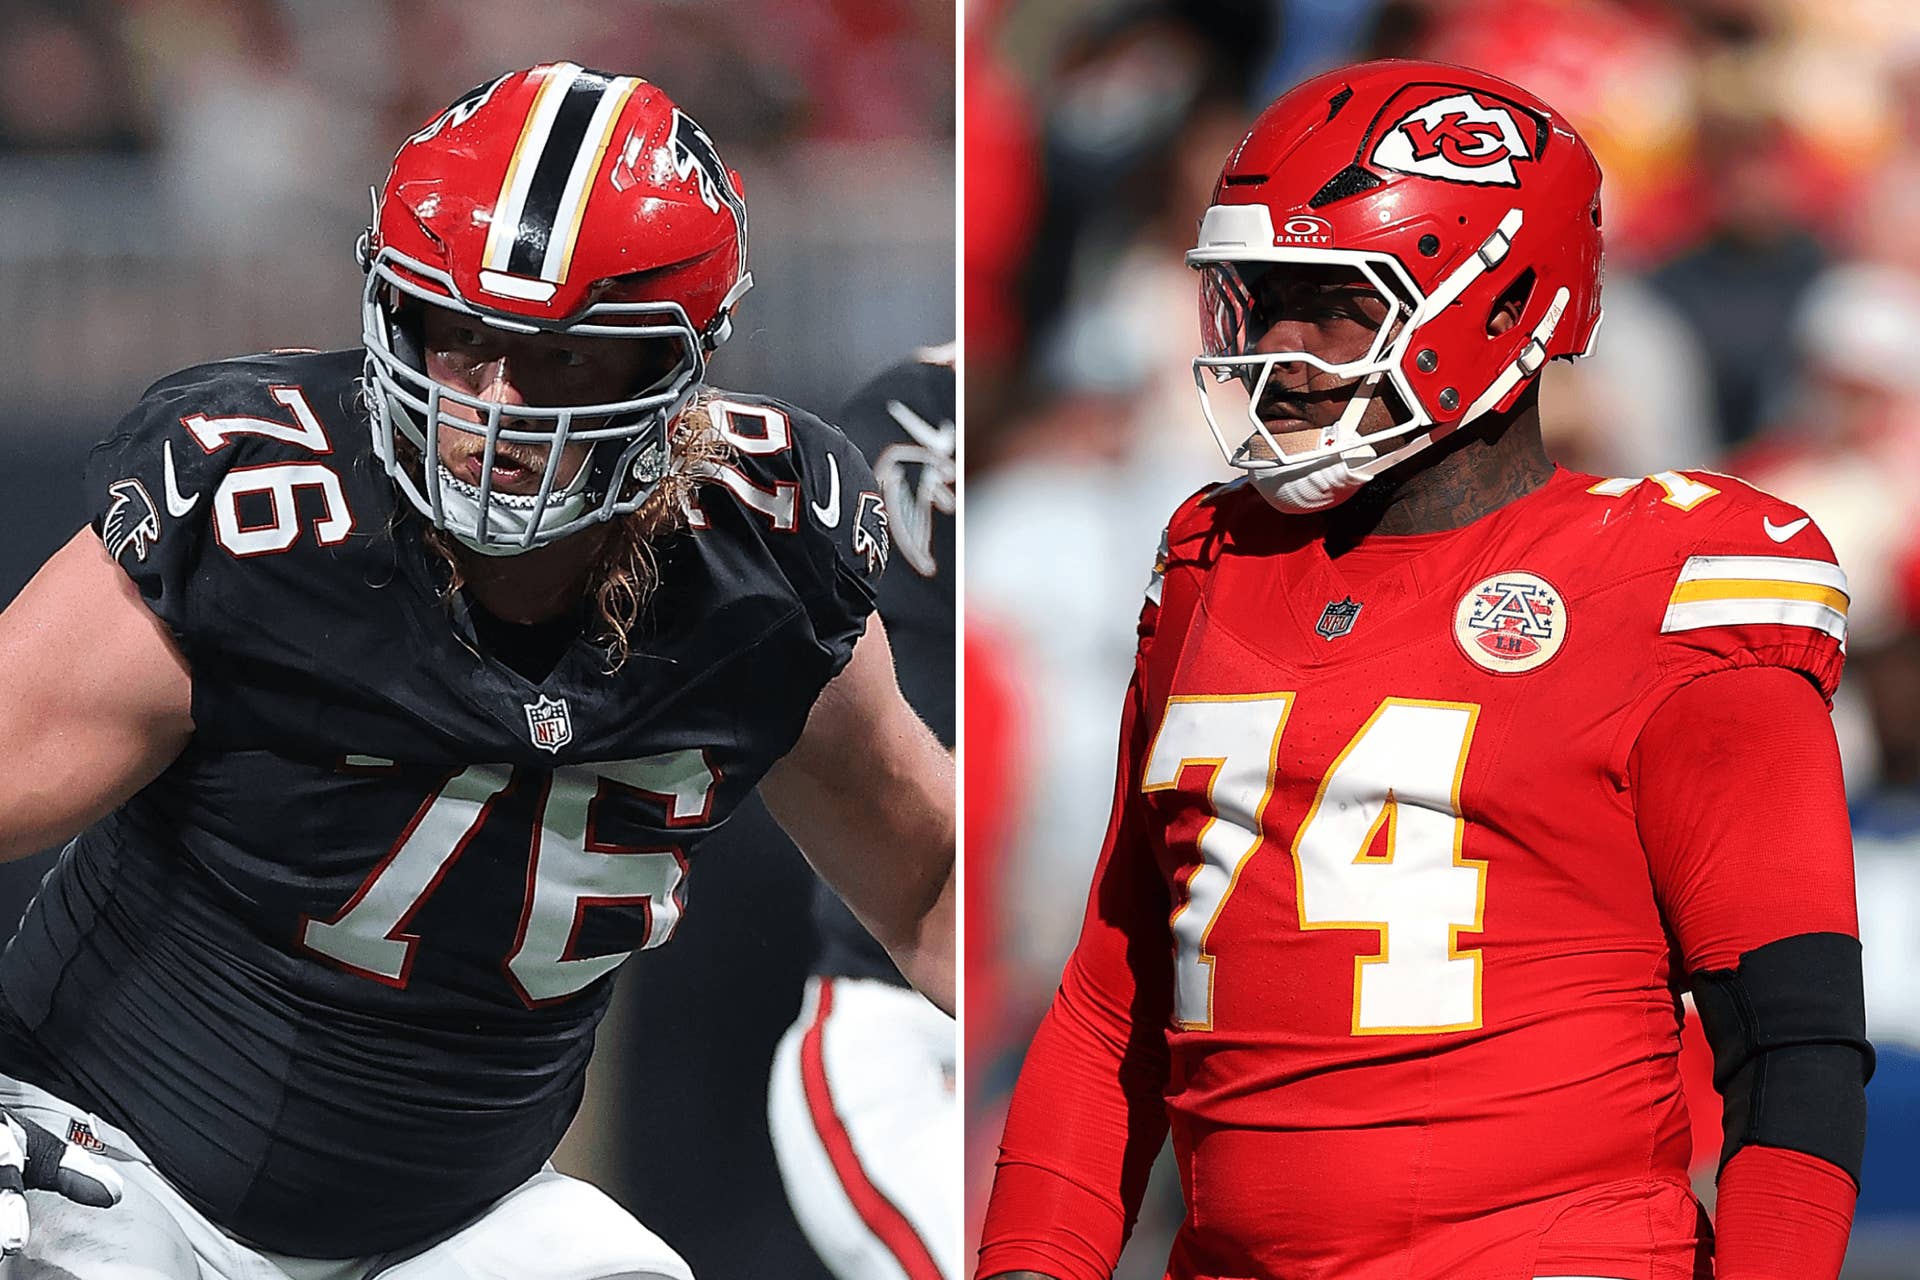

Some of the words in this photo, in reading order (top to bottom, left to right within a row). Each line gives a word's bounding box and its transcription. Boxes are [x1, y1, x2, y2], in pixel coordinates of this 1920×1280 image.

[1398, 112, 1510, 168] KC
[1276, 235, 1328, 243] OAKLEY
[179, 384, 357, 560] 76
[535, 719, 567, 744] NFL
[300, 747, 725, 1011] 76
[1139, 691, 1488, 1037] 74
